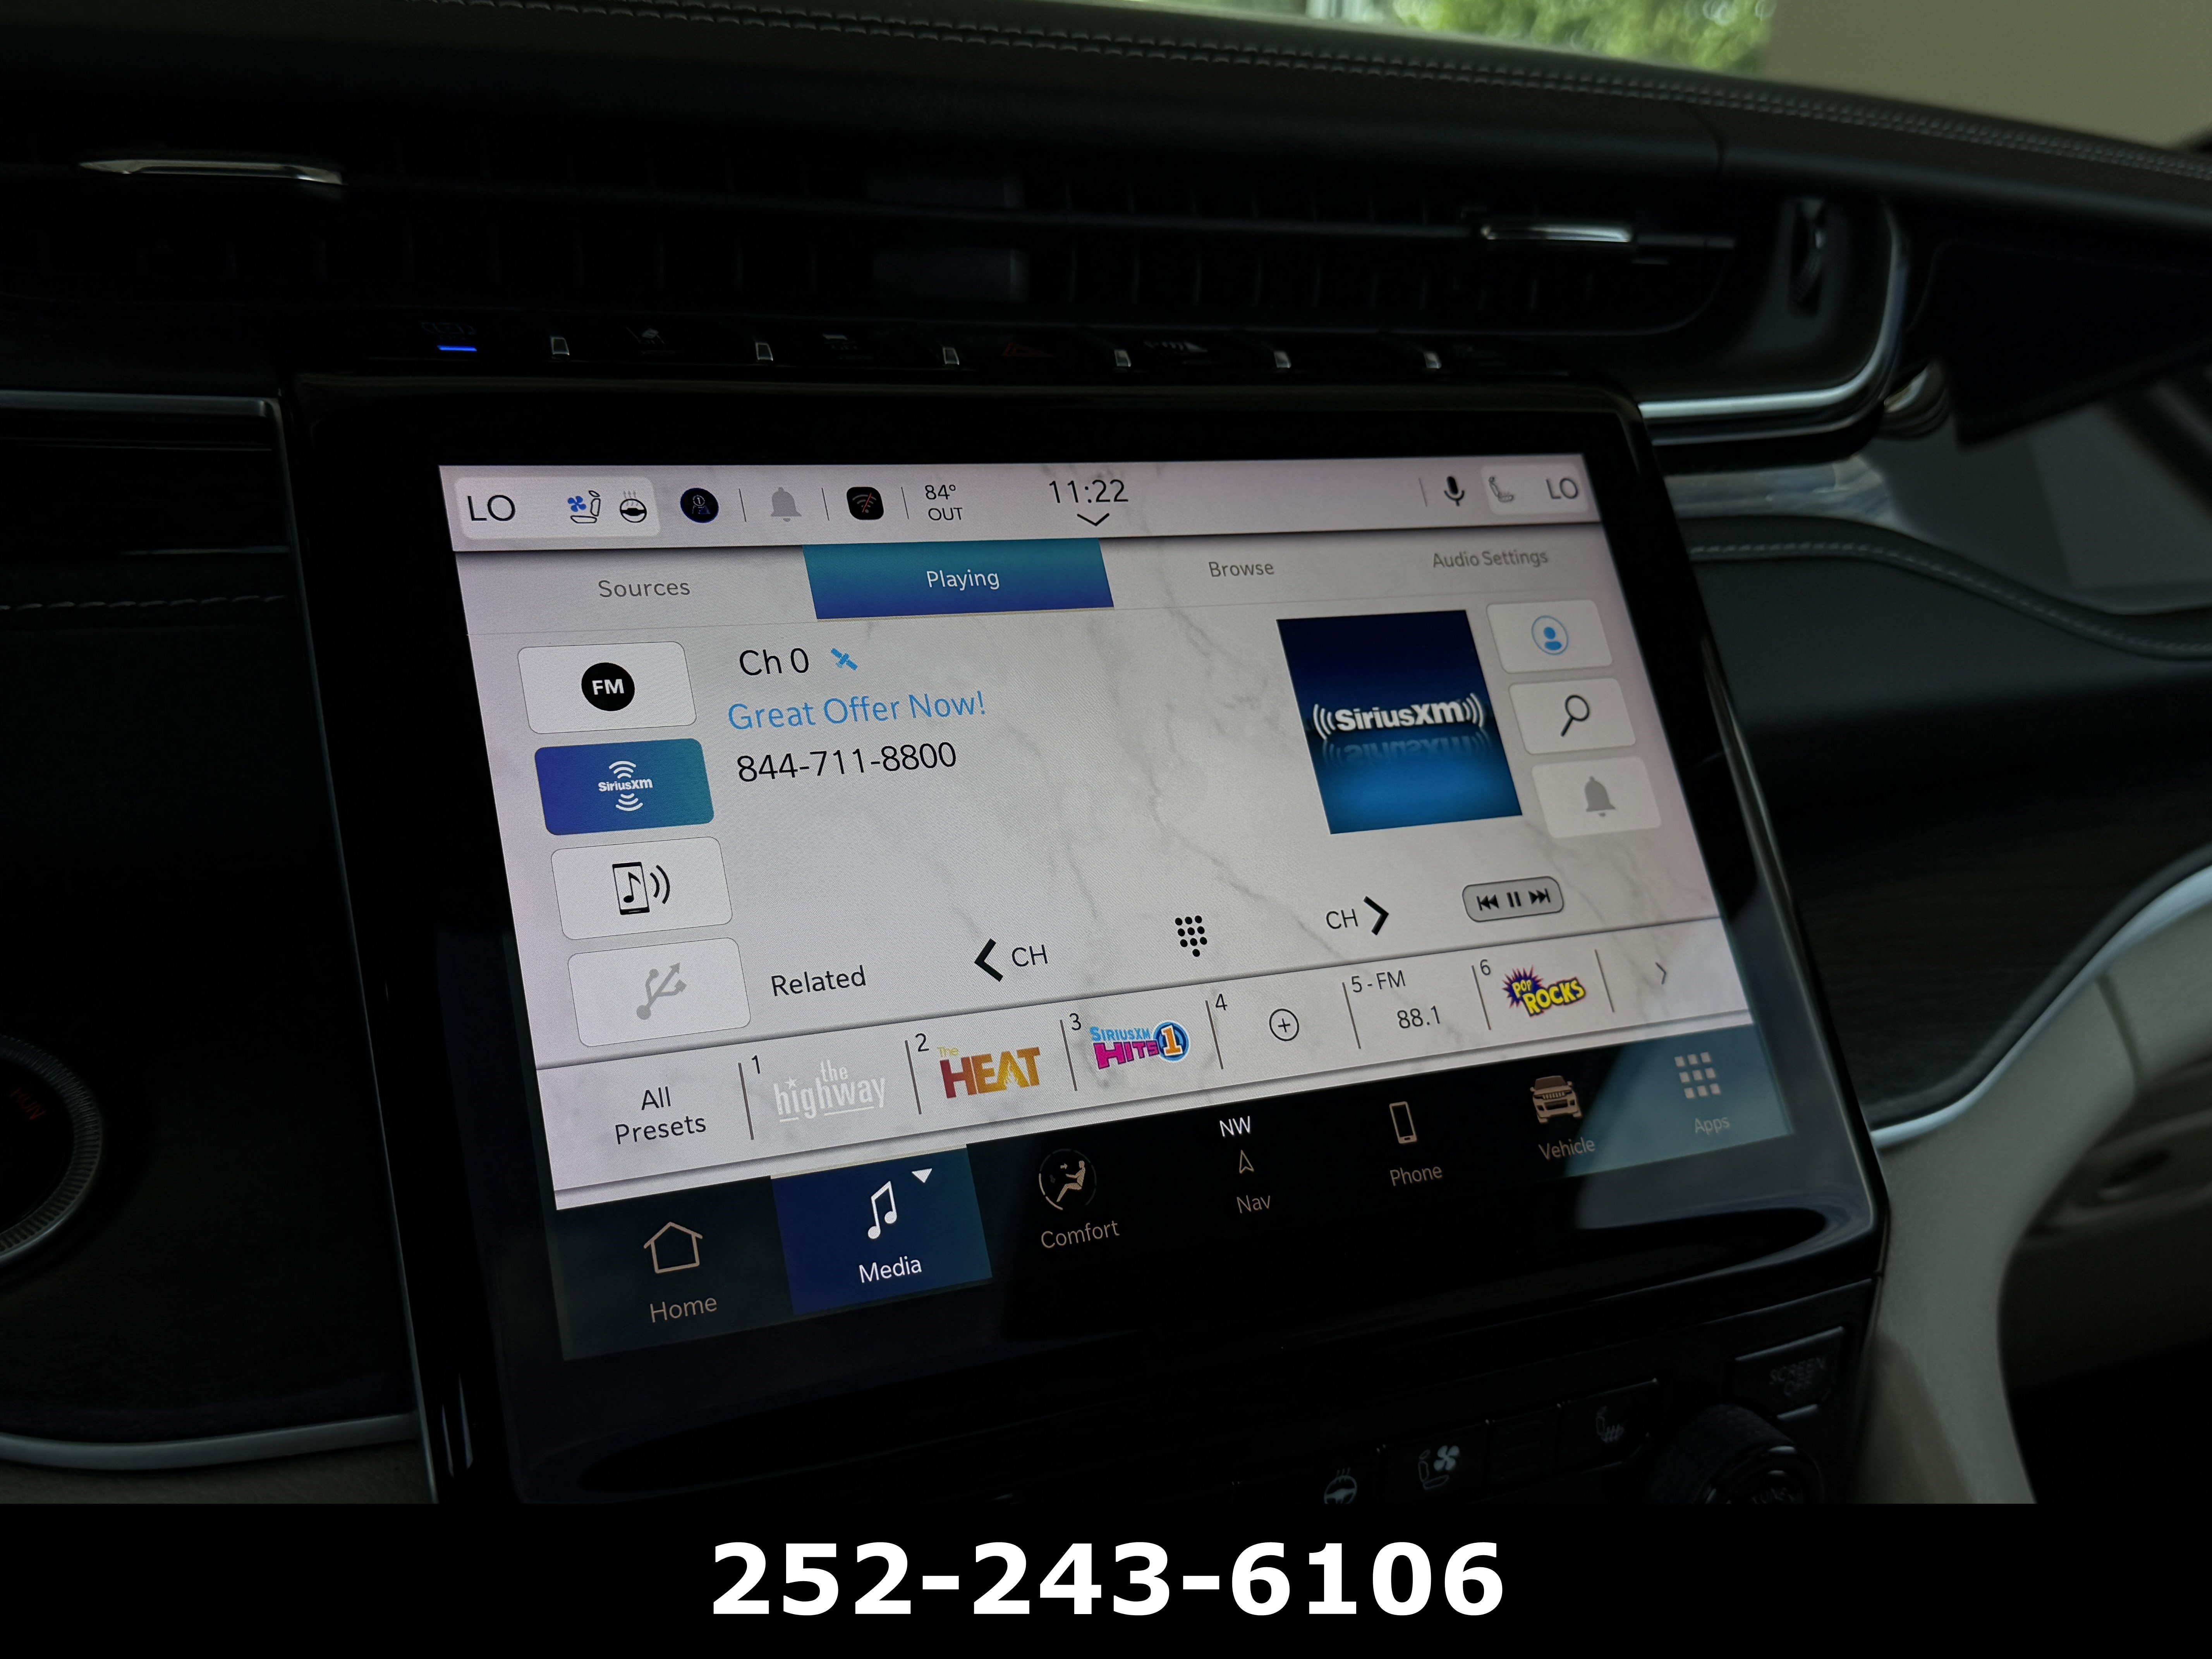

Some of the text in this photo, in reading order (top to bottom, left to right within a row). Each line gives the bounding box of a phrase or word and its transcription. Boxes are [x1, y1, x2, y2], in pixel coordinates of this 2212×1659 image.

[925, 484, 956, 500] 84°
[1049, 479, 1128, 503] 11:22
[1546, 477, 1578, 500] LO
[467, 495, 515, 521] LO
[928, 507, 962, 520] OUT
[1209, 562, 1274, 577] Browse
[1432, 549, 1548, 568] Audio Settings
[598, 580, 690, 597] Sources
[927, 569, 999, 591] Playing
[740, 648, 809, 675] Ch 0
[592, 679, 624, 695] FM
[728, 691, 985, 730] Great Offer Now!
[737, 742, 956, 782] 844-711-8800
[1326, 909, 1358, 929] CH
[1012, 945, 1048, 967] CH
[1480, 959, 1491, 975] 6
[771, 965, 866, 996] Related
[1352, 976, 1362, 993] 5
[1376, 970, 1405, 989] FM
[1512, 980, 1532, 998] POP
[1216, 994, 1227, 1010] 4
[1522, 980, 1585, 1015] ROCKS
[1070, 1013, 1081, 1030] 3
[1397, 1006, 1440, 1029] 88.1
[915, 1033, 929, 1052] 2
[1092, 1025, 1183, 1070] HITS 1
[752, 1055, 760, 1074] 1
[820, 1059, 847, 1083] the
[939, 1046, 1041, 1099] HEAT
[642, 1087, 670, 1110] All
[774, 1077, 886, 1119] highway
[615, 1116, 706, 1144] Presets
[1219, 1116, 1250, 1137] NW
[1694, 1115, 1730, 1135] Apps
[1539, 1137, 1595, 1161] Vehicle
[1390, 1166, 1442, 1186] Phone
[1237, 1195, 1270, 1213] Nav
[1041, 1221, 1120, 1248] Comfort
[859, 1256, 922, 1283] Media
[650, 1298, 716, 1322] Home
